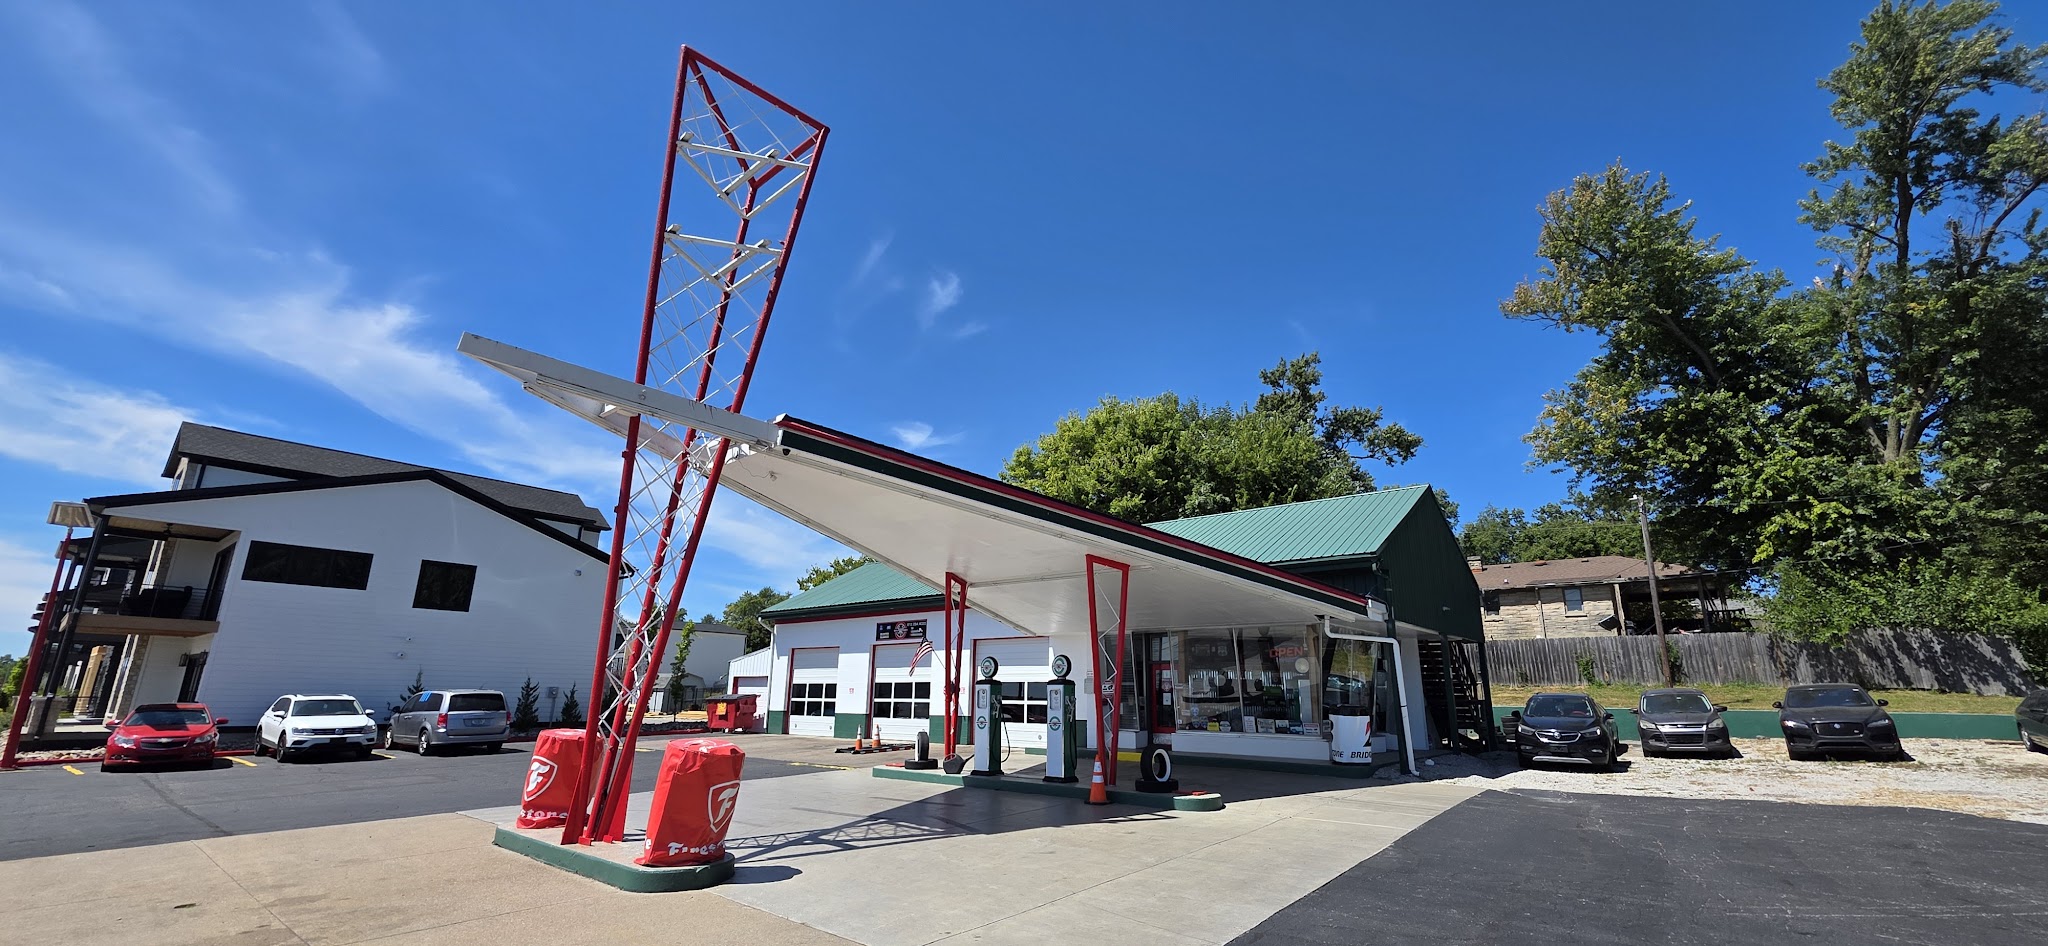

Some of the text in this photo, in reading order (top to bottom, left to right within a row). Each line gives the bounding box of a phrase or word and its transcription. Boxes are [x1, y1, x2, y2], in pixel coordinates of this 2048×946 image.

[1269, 646, 1303, 658] OPEN
[526, 761, 551, 792] F
[713, 786, 739, 824] F
